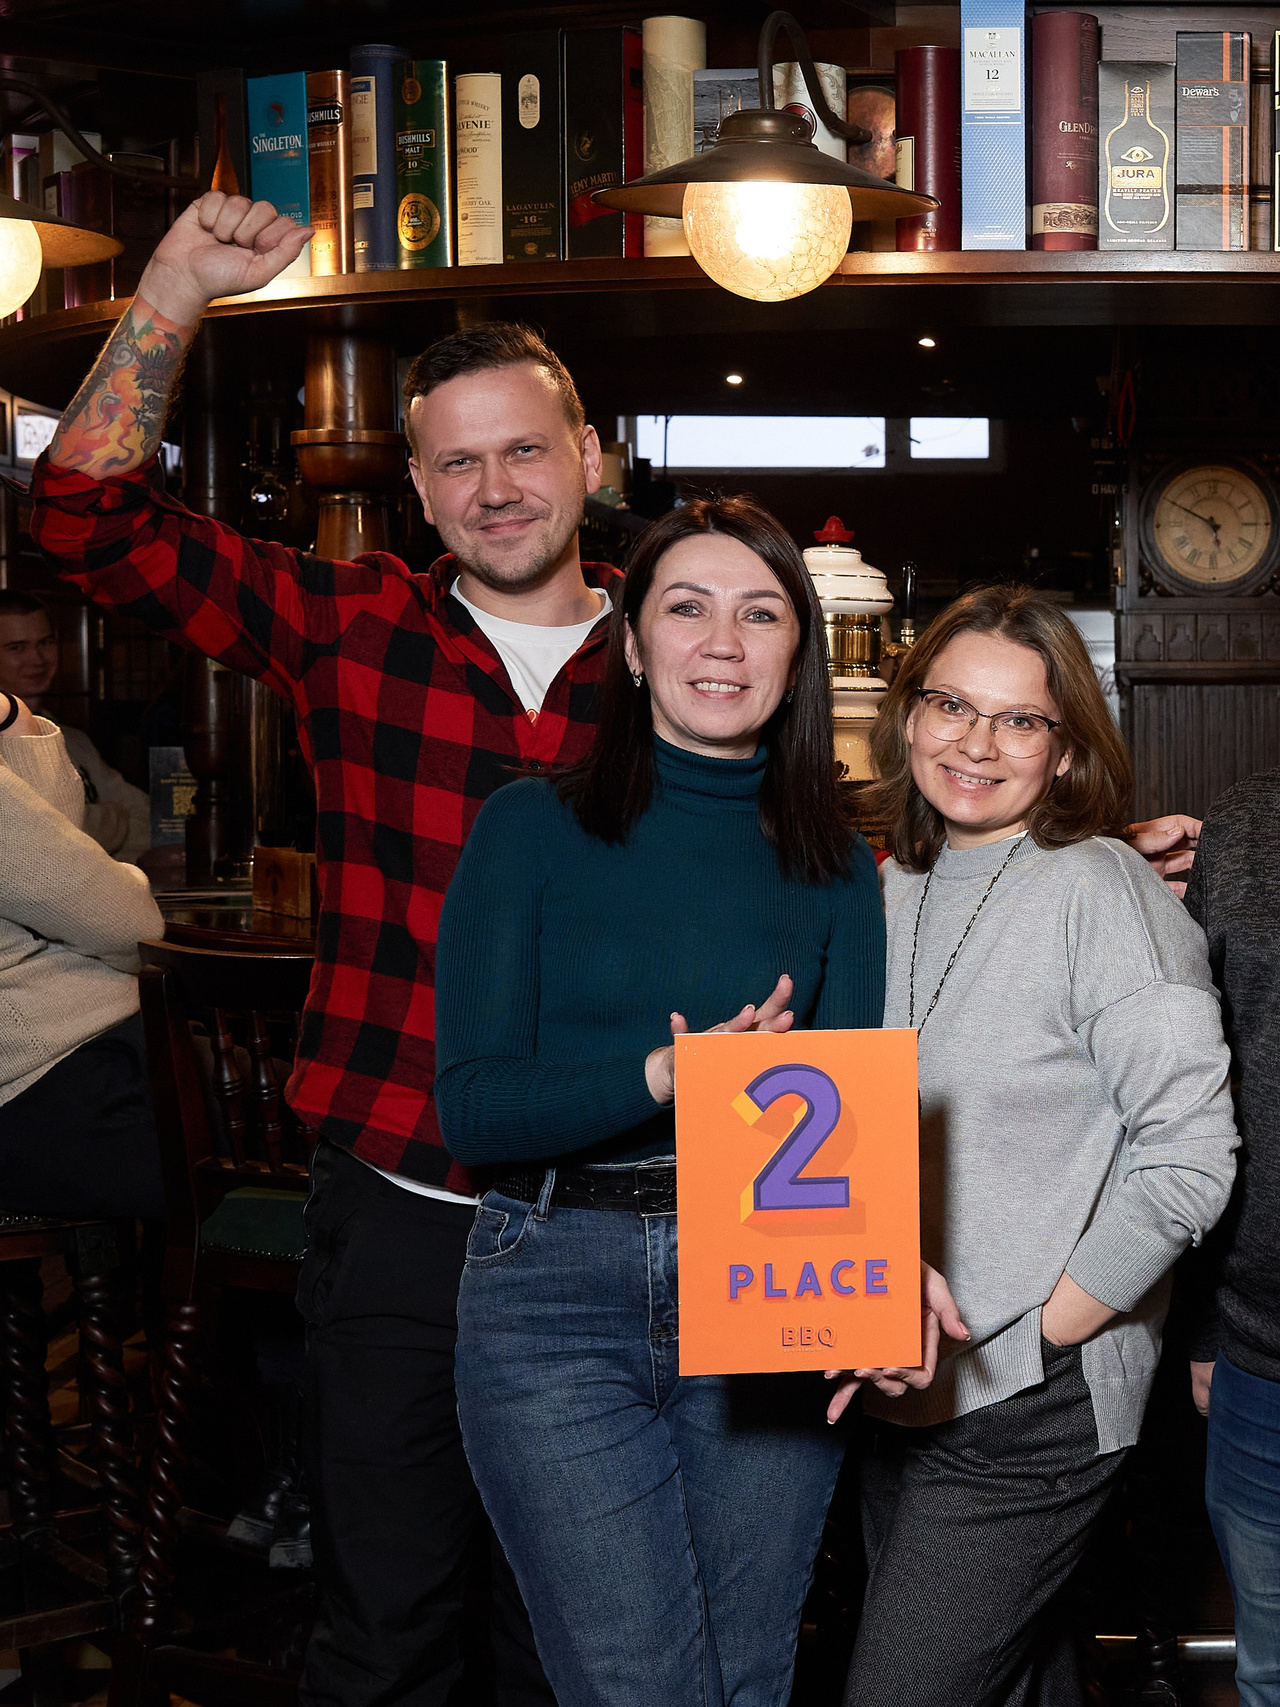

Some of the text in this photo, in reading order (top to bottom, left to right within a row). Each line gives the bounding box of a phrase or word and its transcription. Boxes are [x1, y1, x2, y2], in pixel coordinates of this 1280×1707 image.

[985, 69, 1000, 80] 12
[307, 109, 340, 123] USHMILLS
[252, 134, 302, 154] SINGLETON
[398, 133, 432, 145] BUSHMILLS
[404, 146, 421, 154] MALT
[408, 161, 418, 169] 10
[1117, 169, 1155, 178] JURA
[505, 202, 557, 211] LAGAVULIN
[736, 1063, 850, 1219] 2
[727, 1259, 888, 1301] PLACE
[781, 1326, 836, 1348] BBQ
